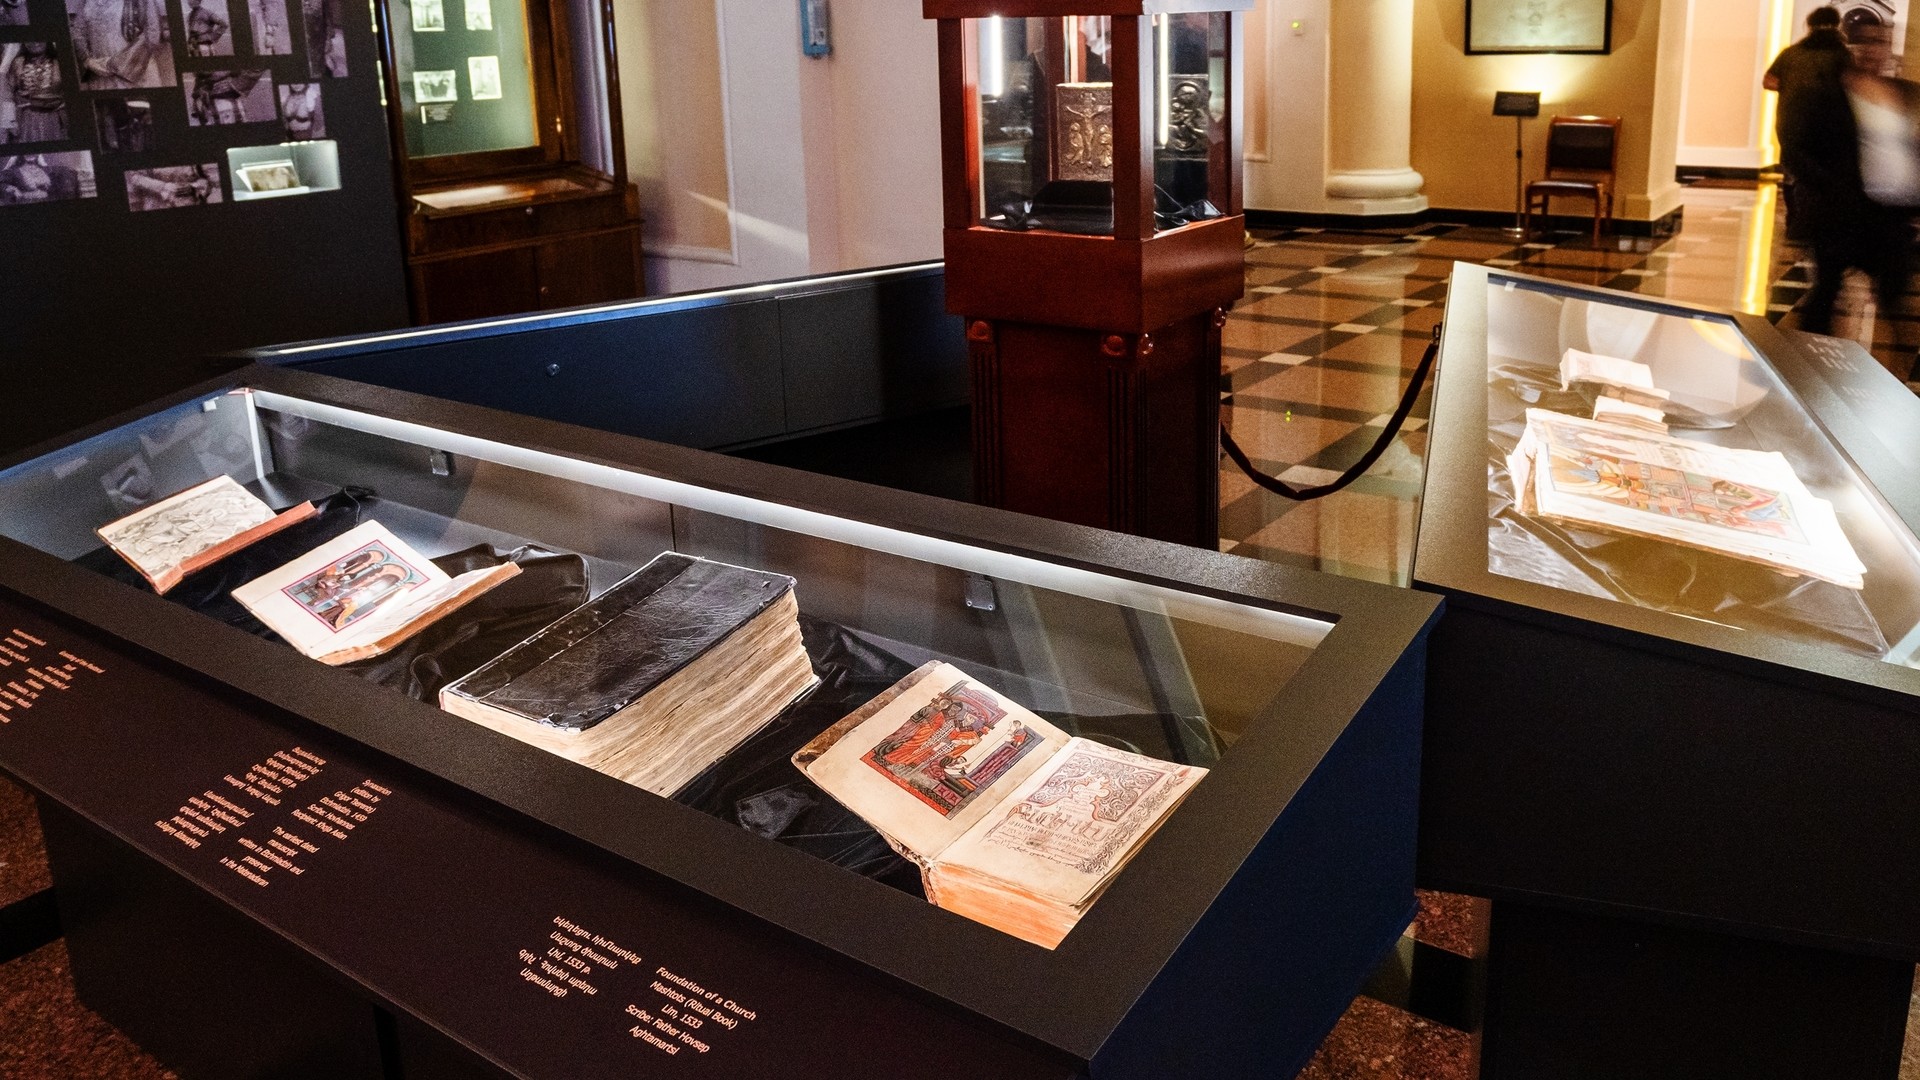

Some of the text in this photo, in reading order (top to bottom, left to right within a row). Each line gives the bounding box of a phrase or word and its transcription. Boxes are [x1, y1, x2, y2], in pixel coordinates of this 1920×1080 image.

[564, 956, 585, 970] 1533
[650, 980, 738, 1030] Mashtots (Ritual Book)
[656, 966, 756, 1021] Foundation of a Church
[624, 1004, 711, 1054] Scribe: Father Hovsep
[661, 1004, 704, 1029] Lim, 1533
[628, 1025, 680, 1056] Aghtamartsi
